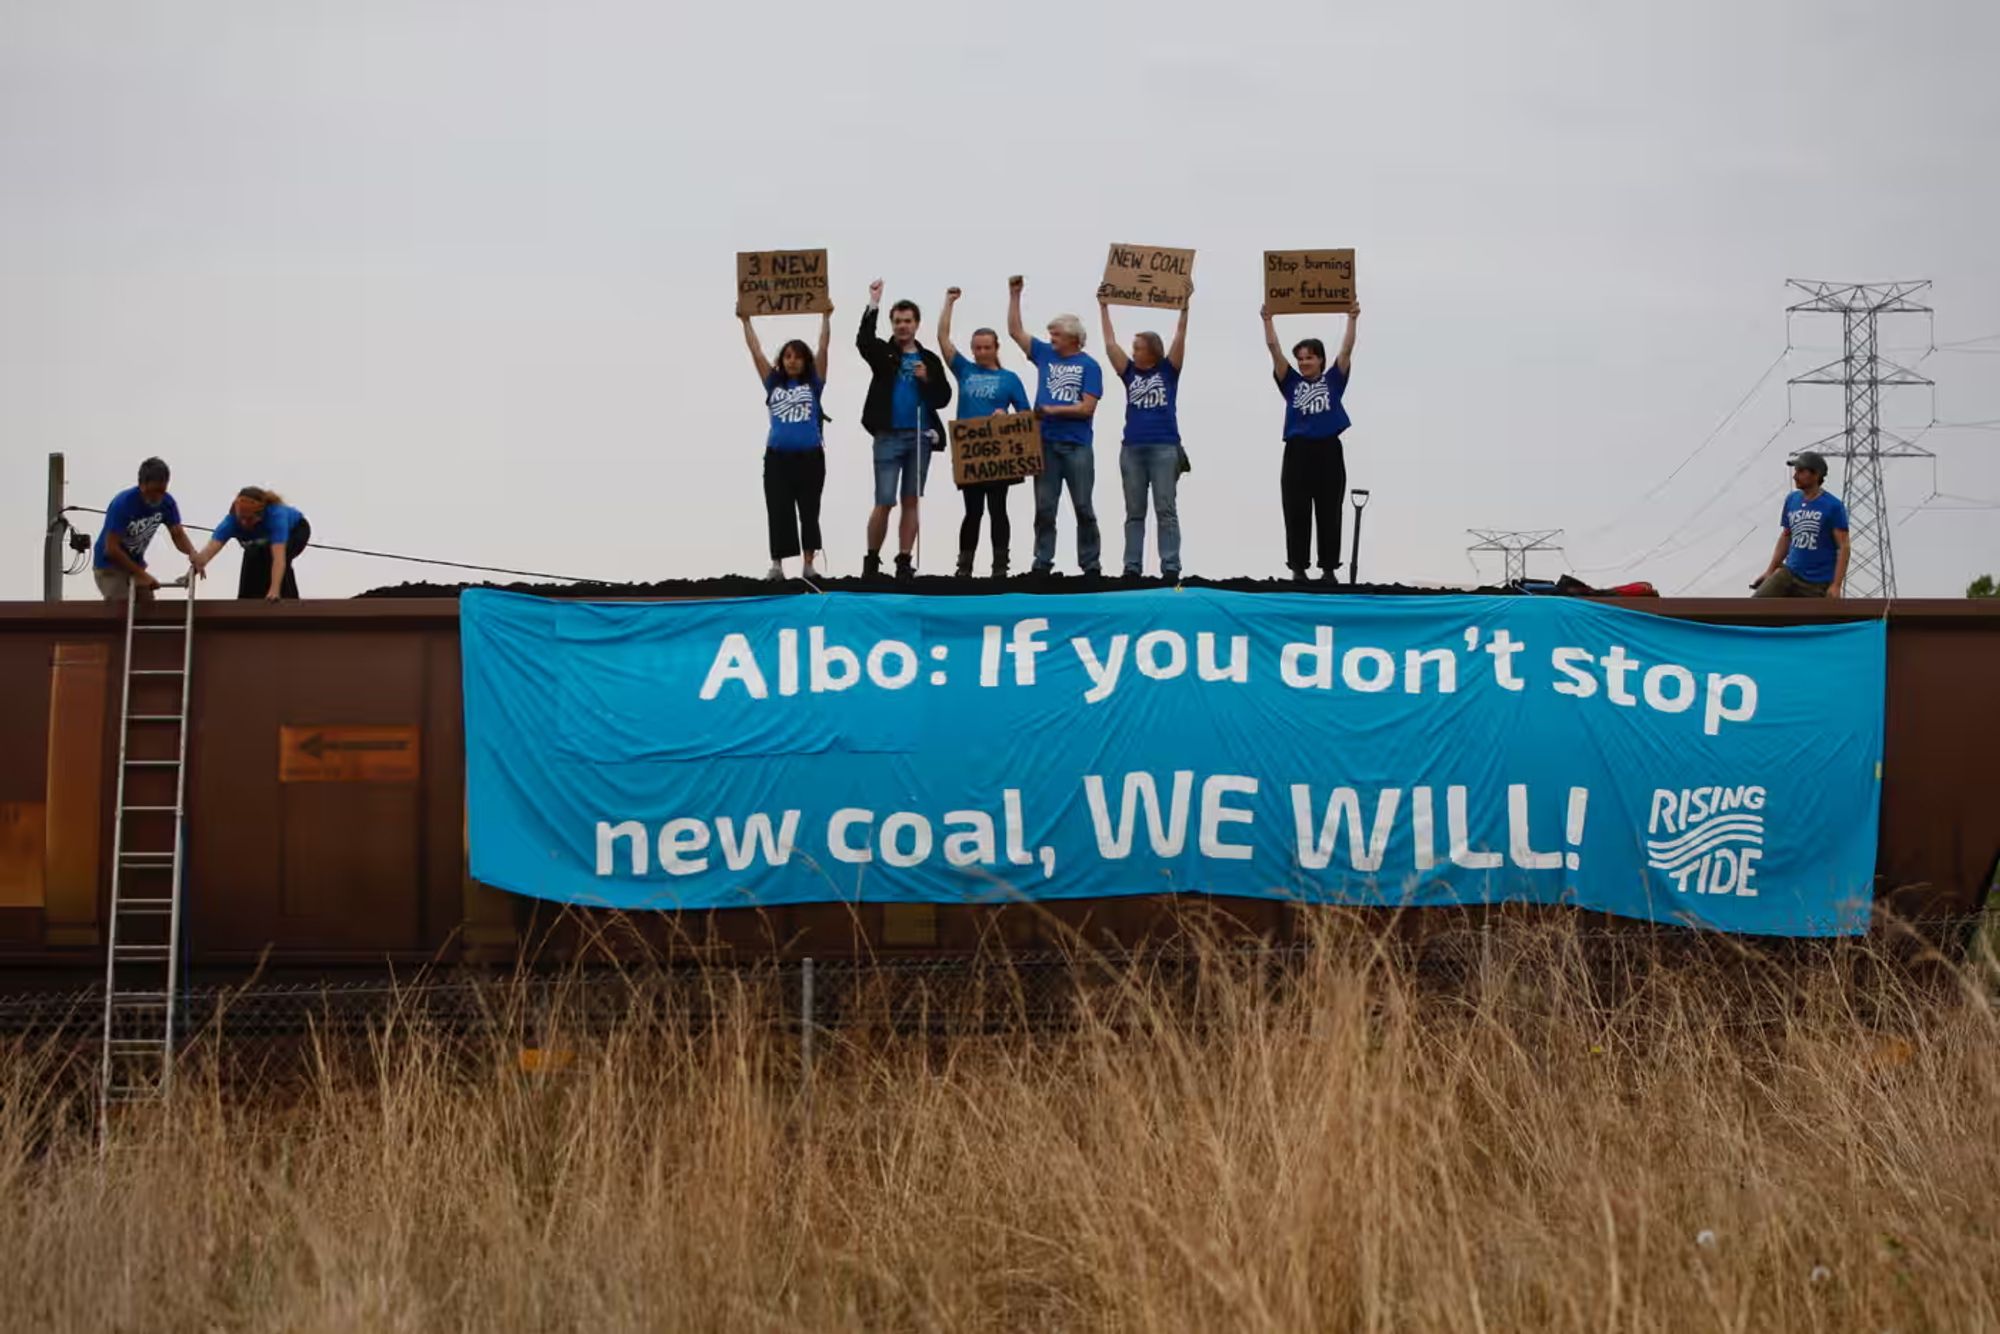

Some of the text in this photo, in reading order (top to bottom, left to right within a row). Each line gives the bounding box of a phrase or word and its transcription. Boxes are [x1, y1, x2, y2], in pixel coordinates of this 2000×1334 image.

[748, 254, 819, 275] 3 NEW
[1110, 249, 1187, 275] NEW COAL
[1268, 255, 1352, 280] Stop burning
[1269, 281, 1350, 299] our future
[1133, 387, 1168, 408] TIDE
[778, 402, 812, 423] TIDE
[953, 419, 1032, 440] Coal until
[1009, 440, 1024, 455] is
[963, 455, 1042, 479] MADNESS!
[700, 627, 947, 699] Albo:
[1072, 630, 1248, 703] you
[1281, 626, 1524, 693] don't
[1553, 646, 1757, 735] stop
[1649, 785, 1766, 834] RISING
[597, 771, 1588, 877] new coal, WE WILL!
[1669, 849, 1763, 897] TIDE
